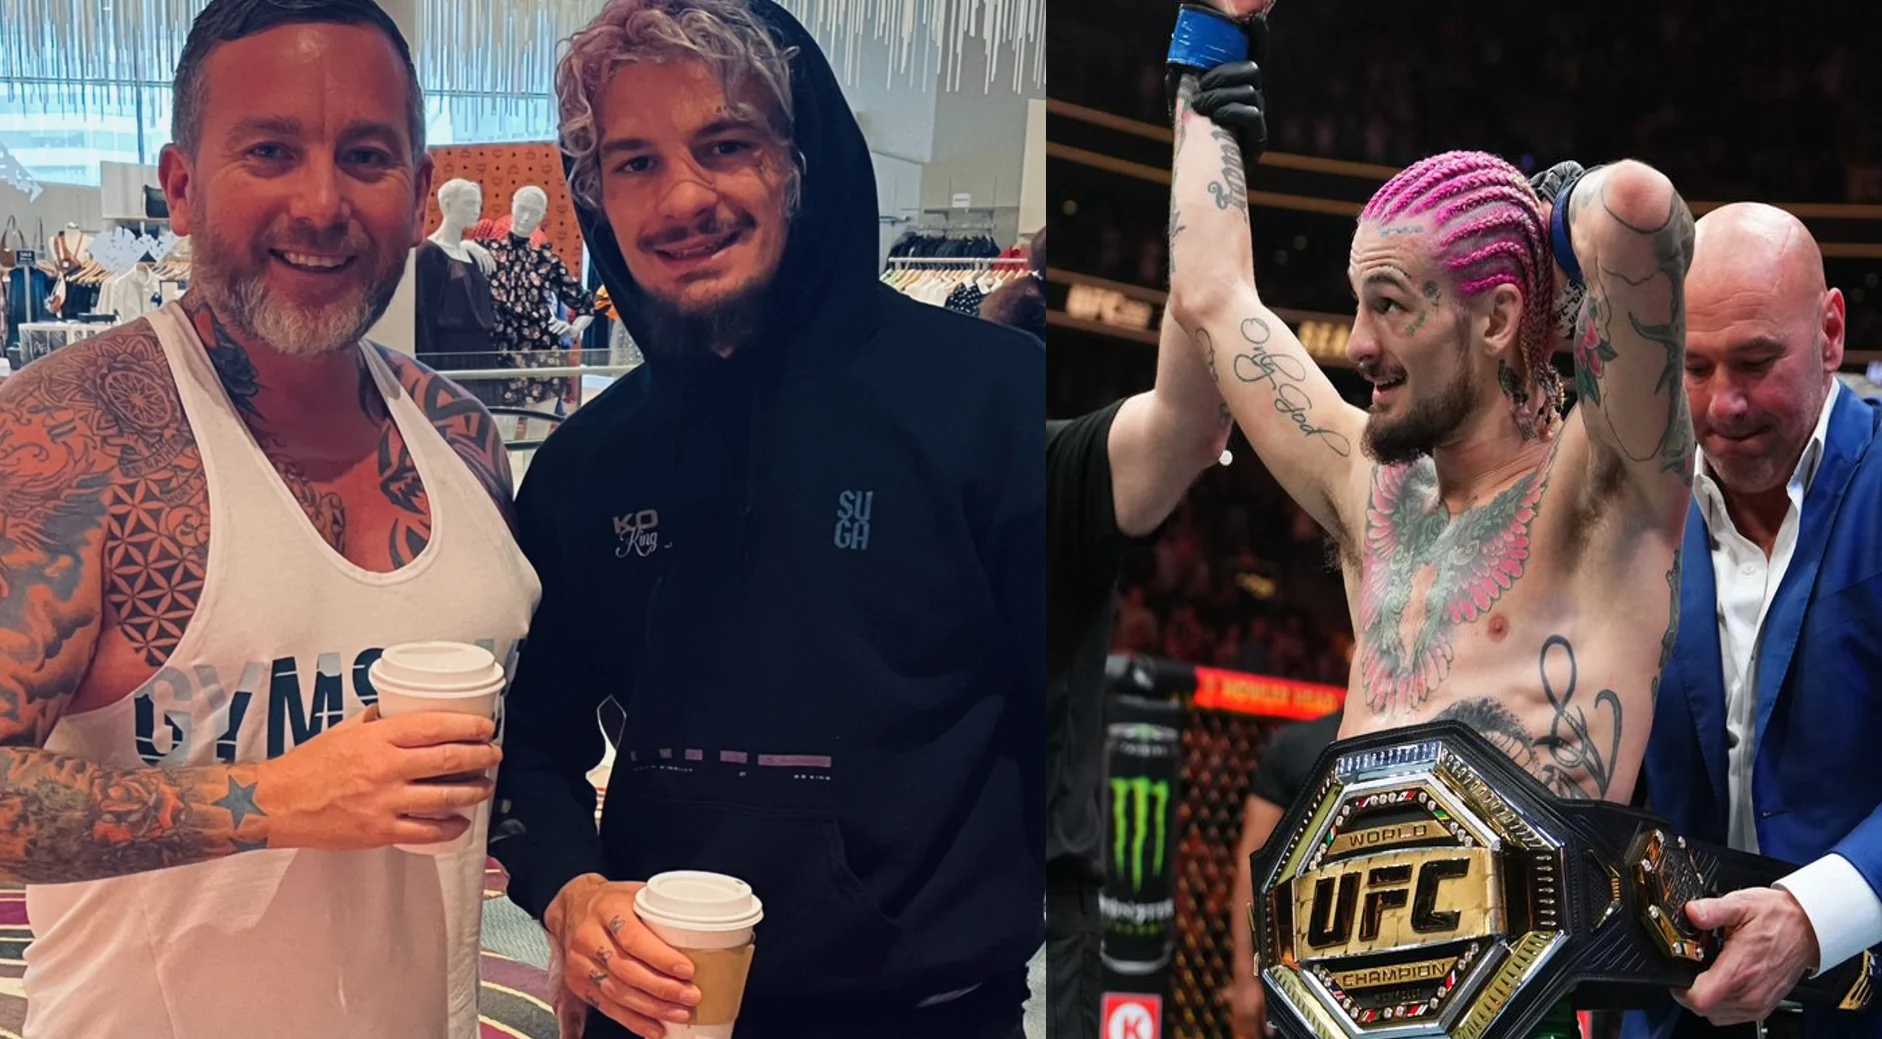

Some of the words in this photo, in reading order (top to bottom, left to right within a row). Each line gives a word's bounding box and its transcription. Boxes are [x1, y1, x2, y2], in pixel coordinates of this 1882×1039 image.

[837, 490, 874, 520] SU
[612, 509, 658, 534] KO
[834, 519, 870, 550] GA
[615, 526, 658, 558] King
[1350, 824, 1428, 847] WORLD
[1307, 857, 1472, 950] UFC
[1342, 962, 1447, 988] CHAMPION
